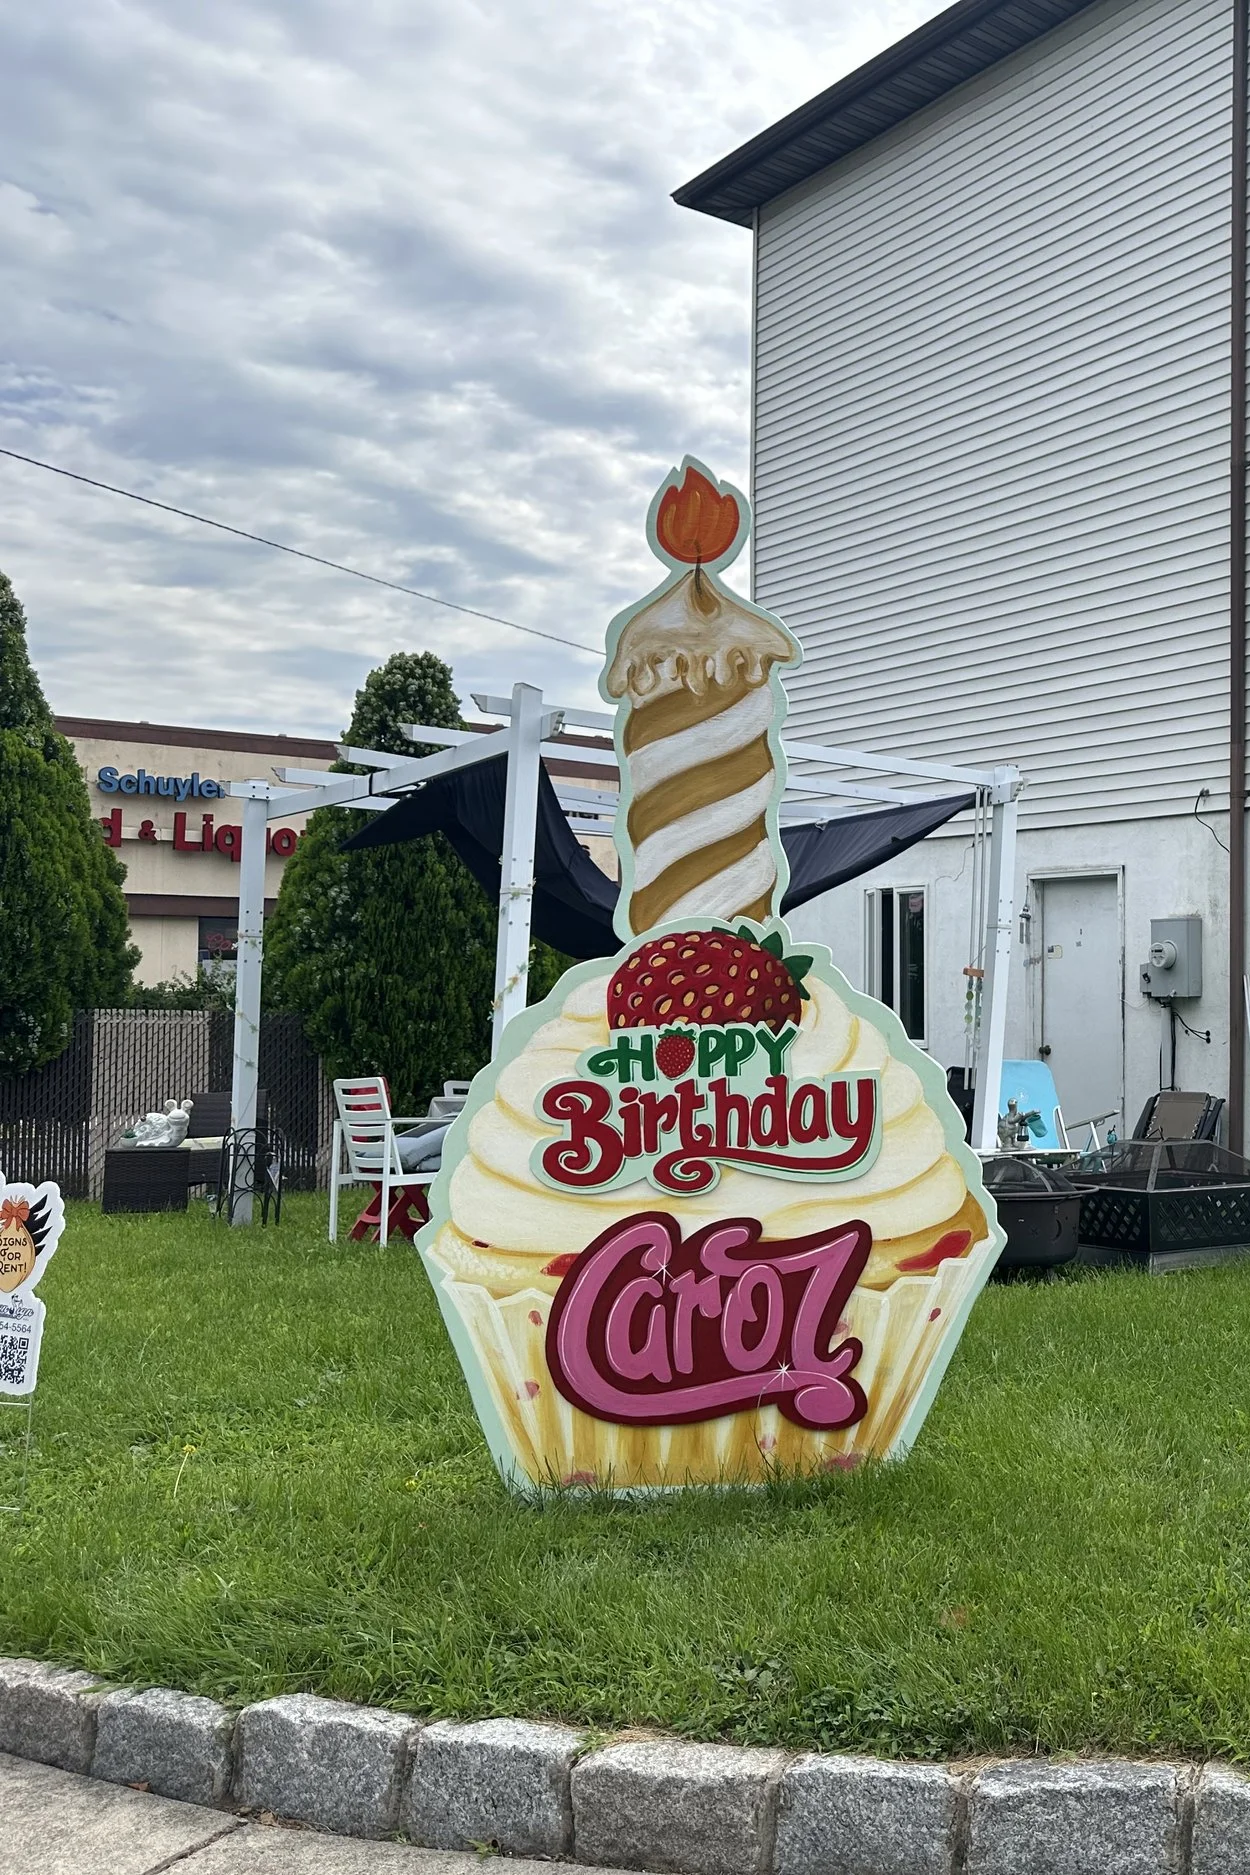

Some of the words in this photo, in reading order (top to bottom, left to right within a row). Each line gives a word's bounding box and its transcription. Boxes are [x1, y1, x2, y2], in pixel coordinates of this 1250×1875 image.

[138, 820, 158, 845] &
[543, 1075, 877, 1190] Birthday
[558, 1220, 861, 1425] Carol
